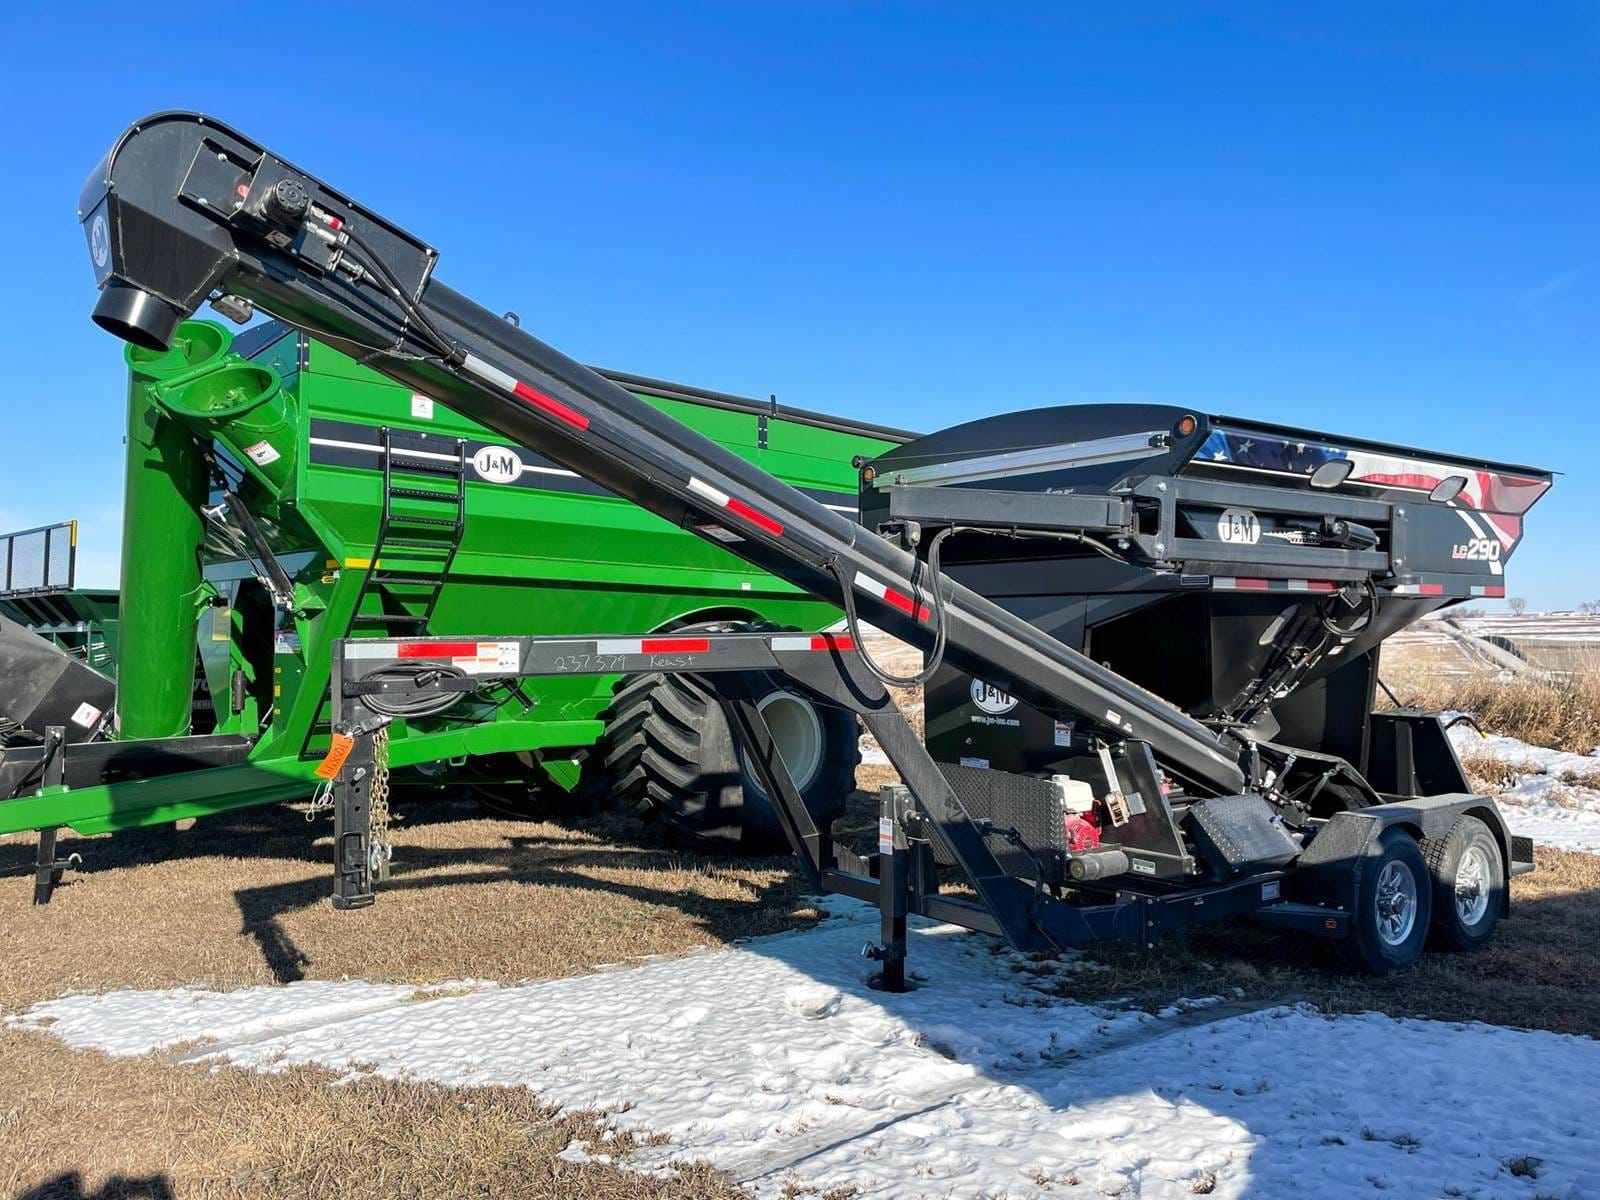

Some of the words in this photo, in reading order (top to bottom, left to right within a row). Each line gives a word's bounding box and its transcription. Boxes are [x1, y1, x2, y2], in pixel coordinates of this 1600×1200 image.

[479, 453, 514, 475] J&M
[1222, 514, 1254, 542] J&M
[554, 654, 626, 672] 237379
